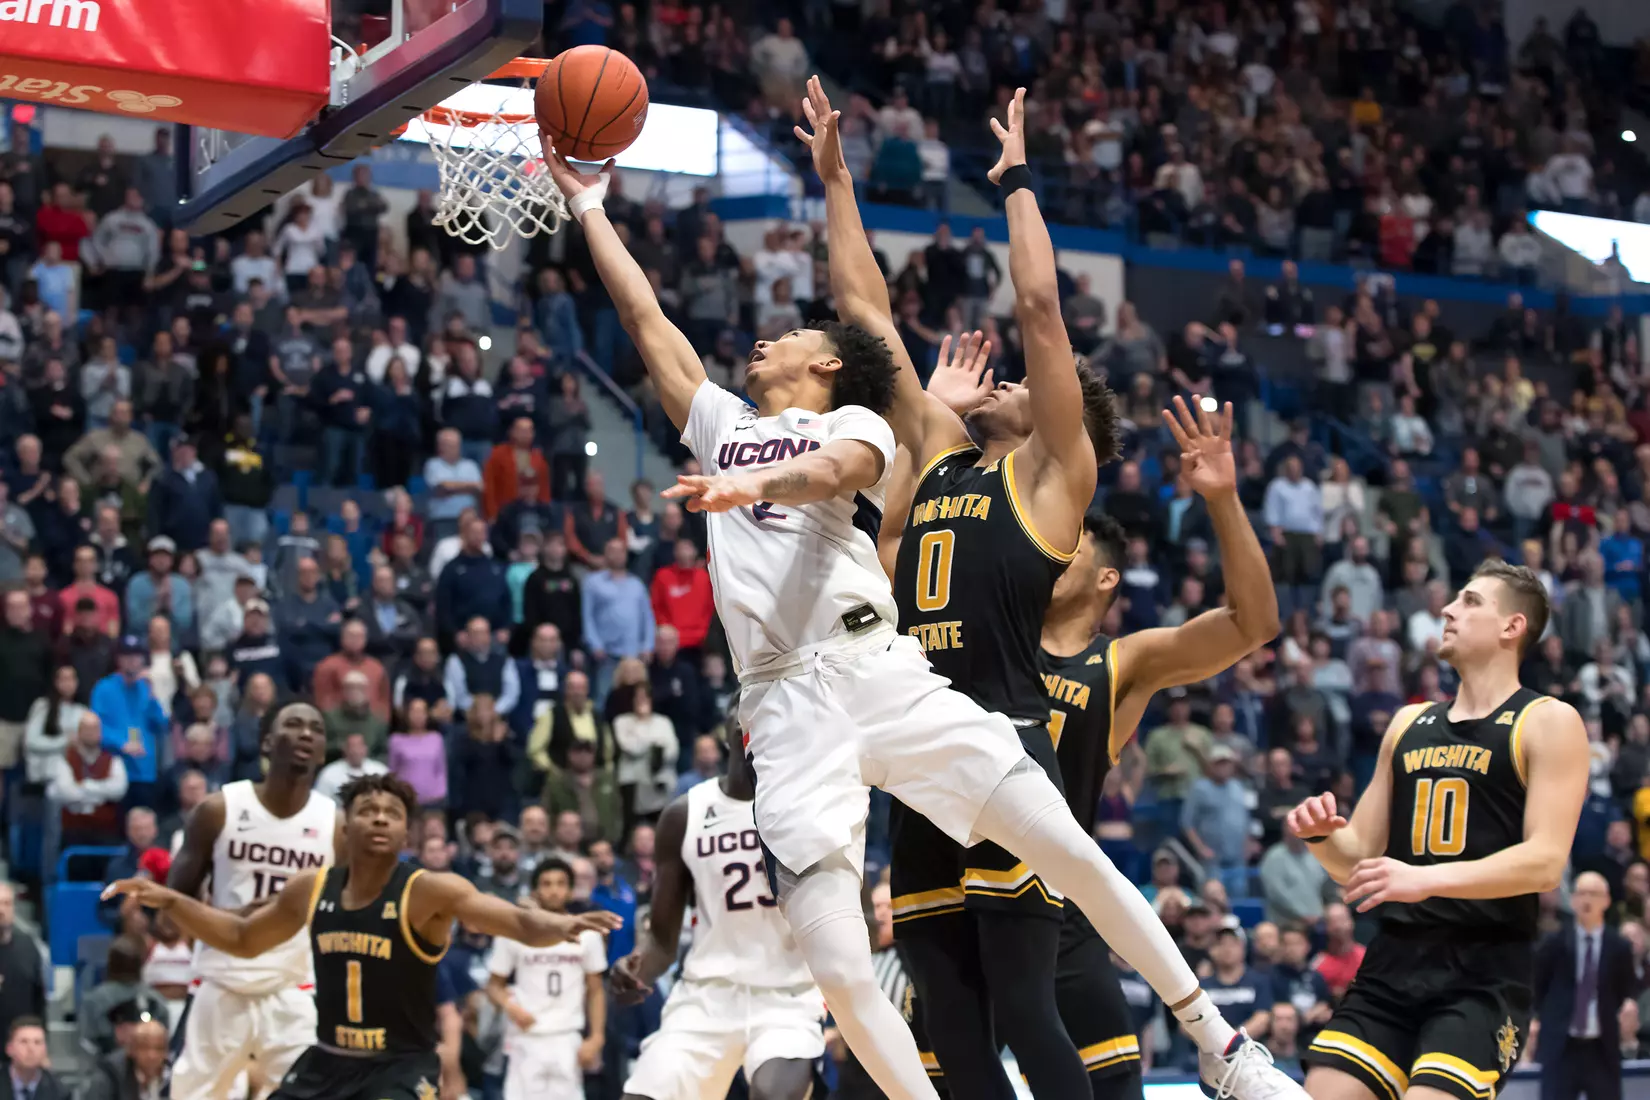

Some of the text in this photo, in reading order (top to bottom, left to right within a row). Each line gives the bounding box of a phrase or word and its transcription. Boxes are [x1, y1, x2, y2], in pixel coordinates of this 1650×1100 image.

[718, 438, 822, 470] UCON
[916, 529, 955, 612] 0
[1403, 744, 1493, 775] WICHITA
[1411, 777, 1470, 856] 10
[228, 840, 325, 869] UCONN
[317, 931, 393, 960] WICHITA
[346, 960, 363, 1024] 1
[547, 969, 562, 998] 0
[335, 1025, 387, 1050] STATE
